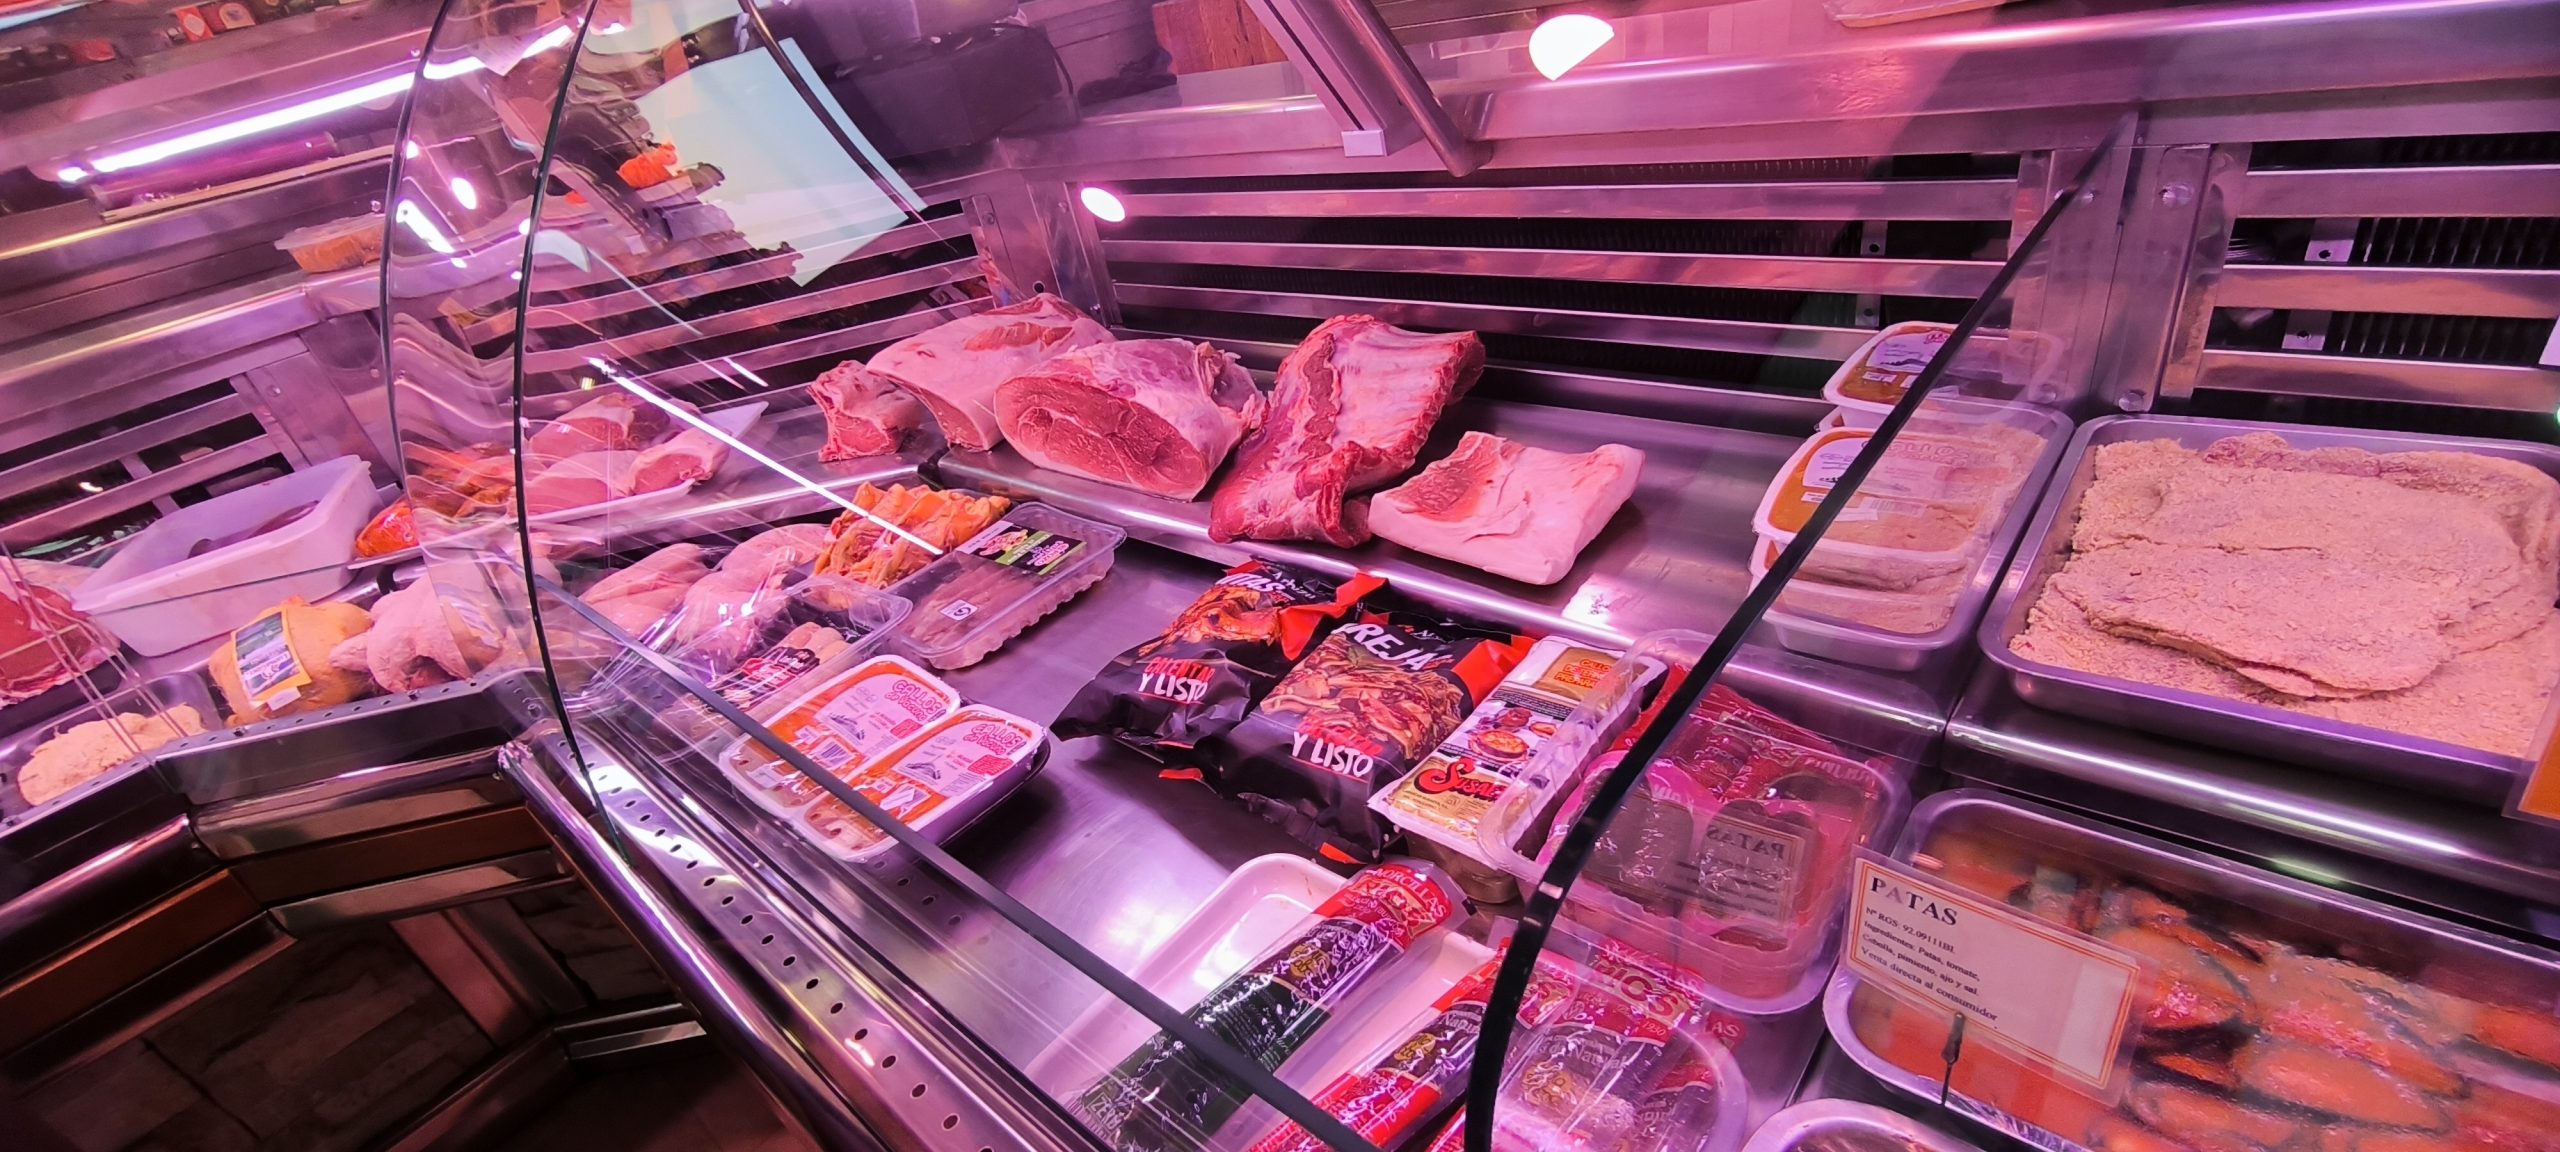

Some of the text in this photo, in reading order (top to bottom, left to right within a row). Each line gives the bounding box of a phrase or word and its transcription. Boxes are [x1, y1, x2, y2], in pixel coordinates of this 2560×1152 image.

[1579, 658, 1610, 673] CALLO
[892, 679, 943, 714] CALLOS
[1138, 673, 1209, 704] Y LISTO
[971, 723, 1024, 748] CALLOS
[1292, 731, 1374, 778] Y LISTO
[1870, 877, 1958, 926] PATAS
[1862, 934, 1895, 957] Cebolla,
[1897, 953, 1937, 977] pimiento,
[1939, 973, 1954, 985] ajo
[1918, 947, 1944, 965] Patas,
[1946, 961, 1980, 982] tomate,
[1861, 946, 1998, 1021] Venta directa al consumidor
